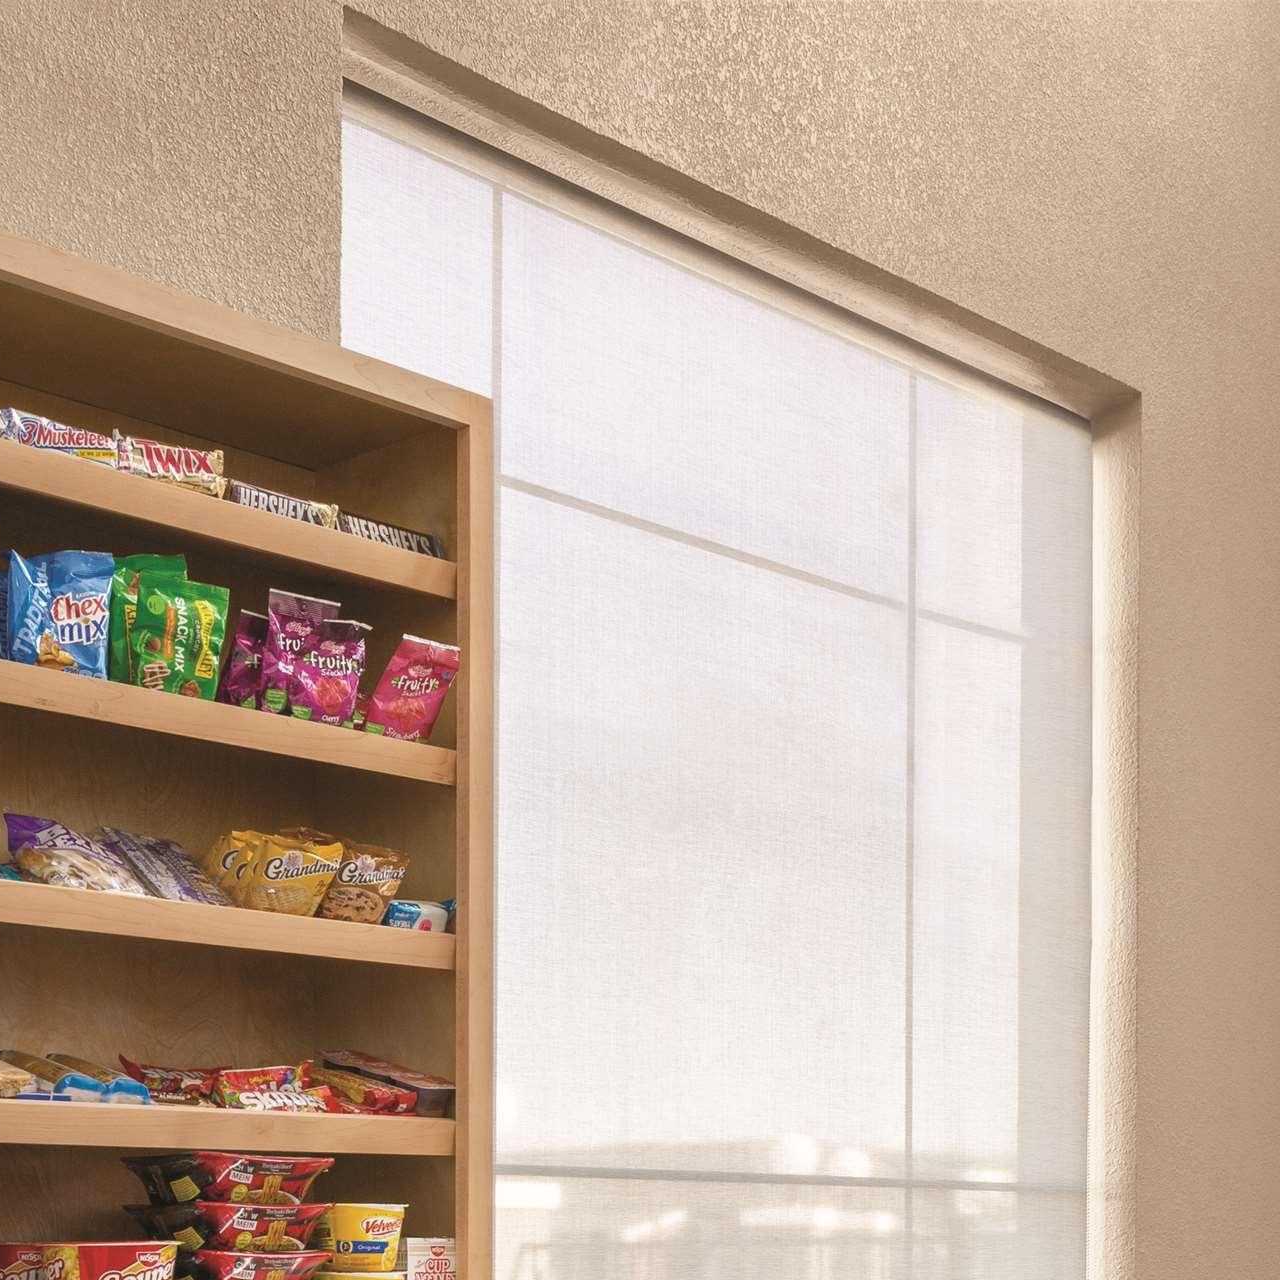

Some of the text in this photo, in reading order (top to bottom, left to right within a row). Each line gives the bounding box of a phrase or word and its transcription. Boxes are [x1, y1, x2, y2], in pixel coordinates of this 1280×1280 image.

[21, 423, 115, 449] 3 Musketee
[132, 439, 215, 475] TWIX
[51, 592, 107, 623] Chex
[60, 615, 107, 645] mix
[174, 596, 189, 673] SNACK MIX
[309, 650, 354, 677] fruity
[397, 674, 437, 695] fruity
[231, 1171, 252, 1183] MEIN
[235, 1220, 255, 1231] MEIN
[356, 1243, 382, 1252] Original
[425, 1258, 451, 1274] CUP
